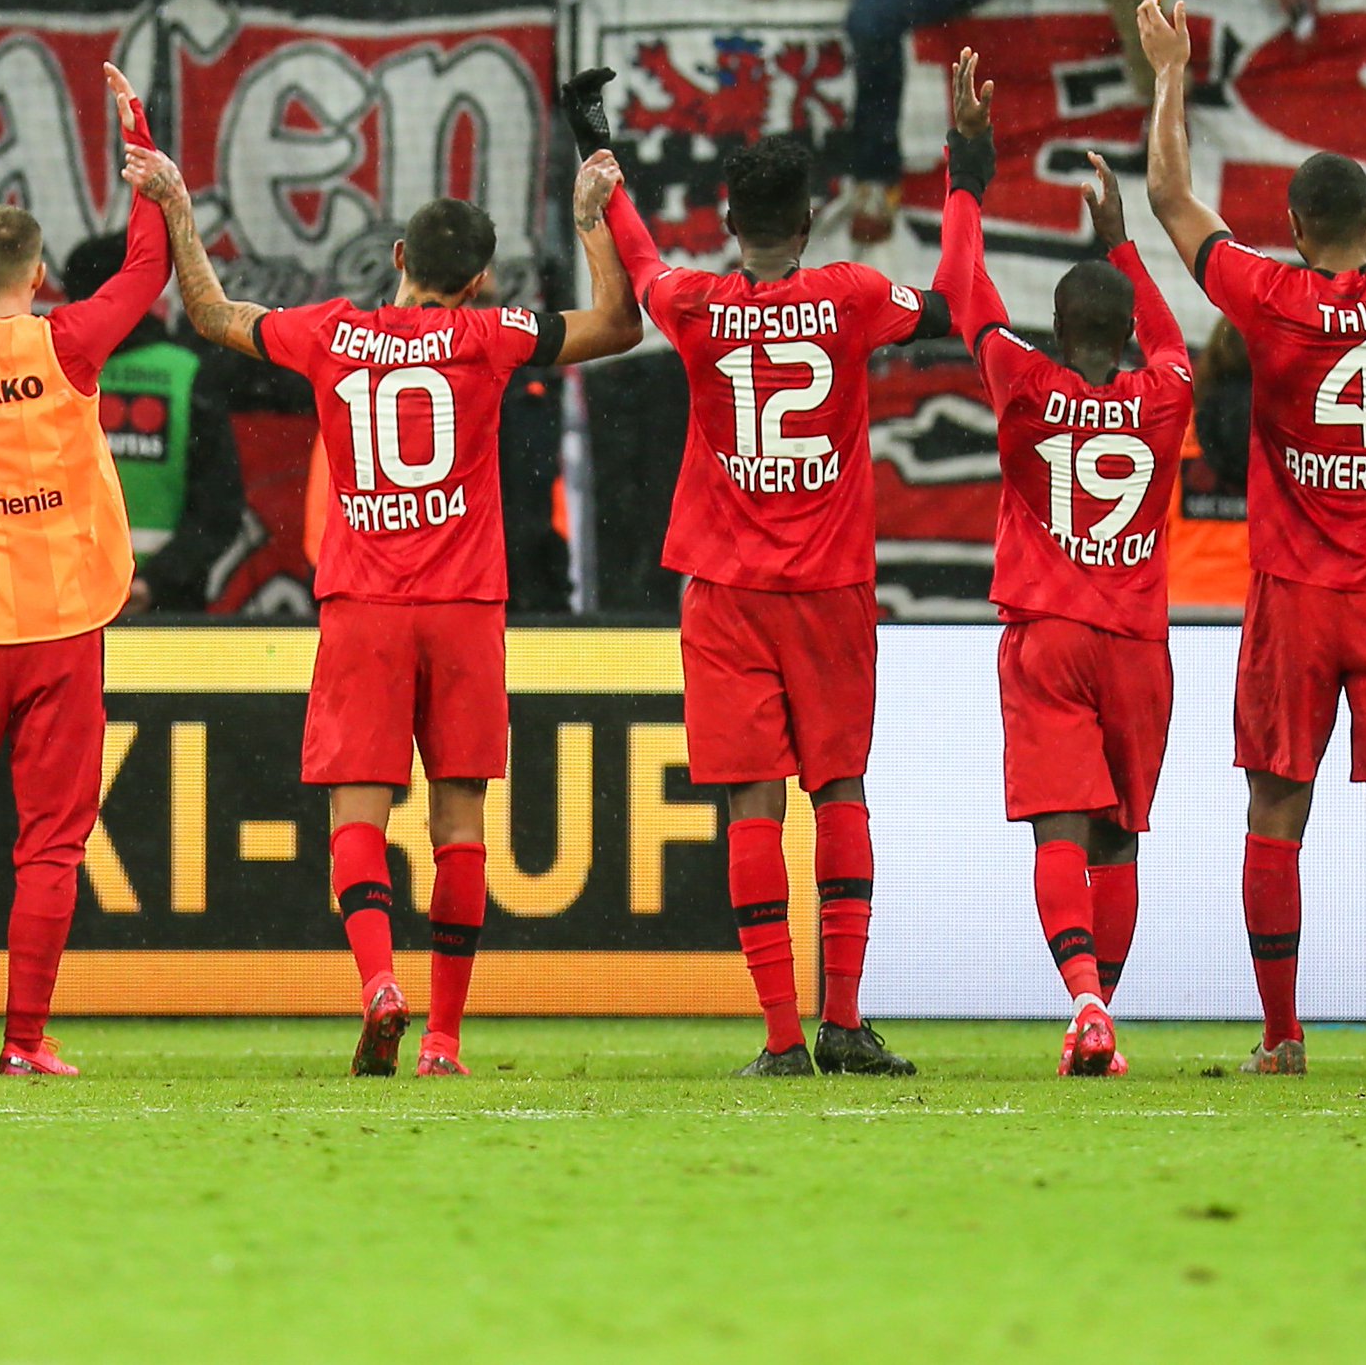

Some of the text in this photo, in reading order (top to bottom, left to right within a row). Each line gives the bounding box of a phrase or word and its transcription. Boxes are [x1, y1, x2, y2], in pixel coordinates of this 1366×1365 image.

[708, 298, 839, 340] TAPSOBA
[330, 320, 454, 365] DEMIRBAY
[714, 340, 834, 458] 12
[1043, 390, 1142, 429] DIABY
[334, 365, 456, 492] 10
[802, 450, 841, 492] 04
[1034, 432, 1156, 542] 19
[424, 484, 467, 526] 04
[1058, 935, 1089, 953] JAKO
